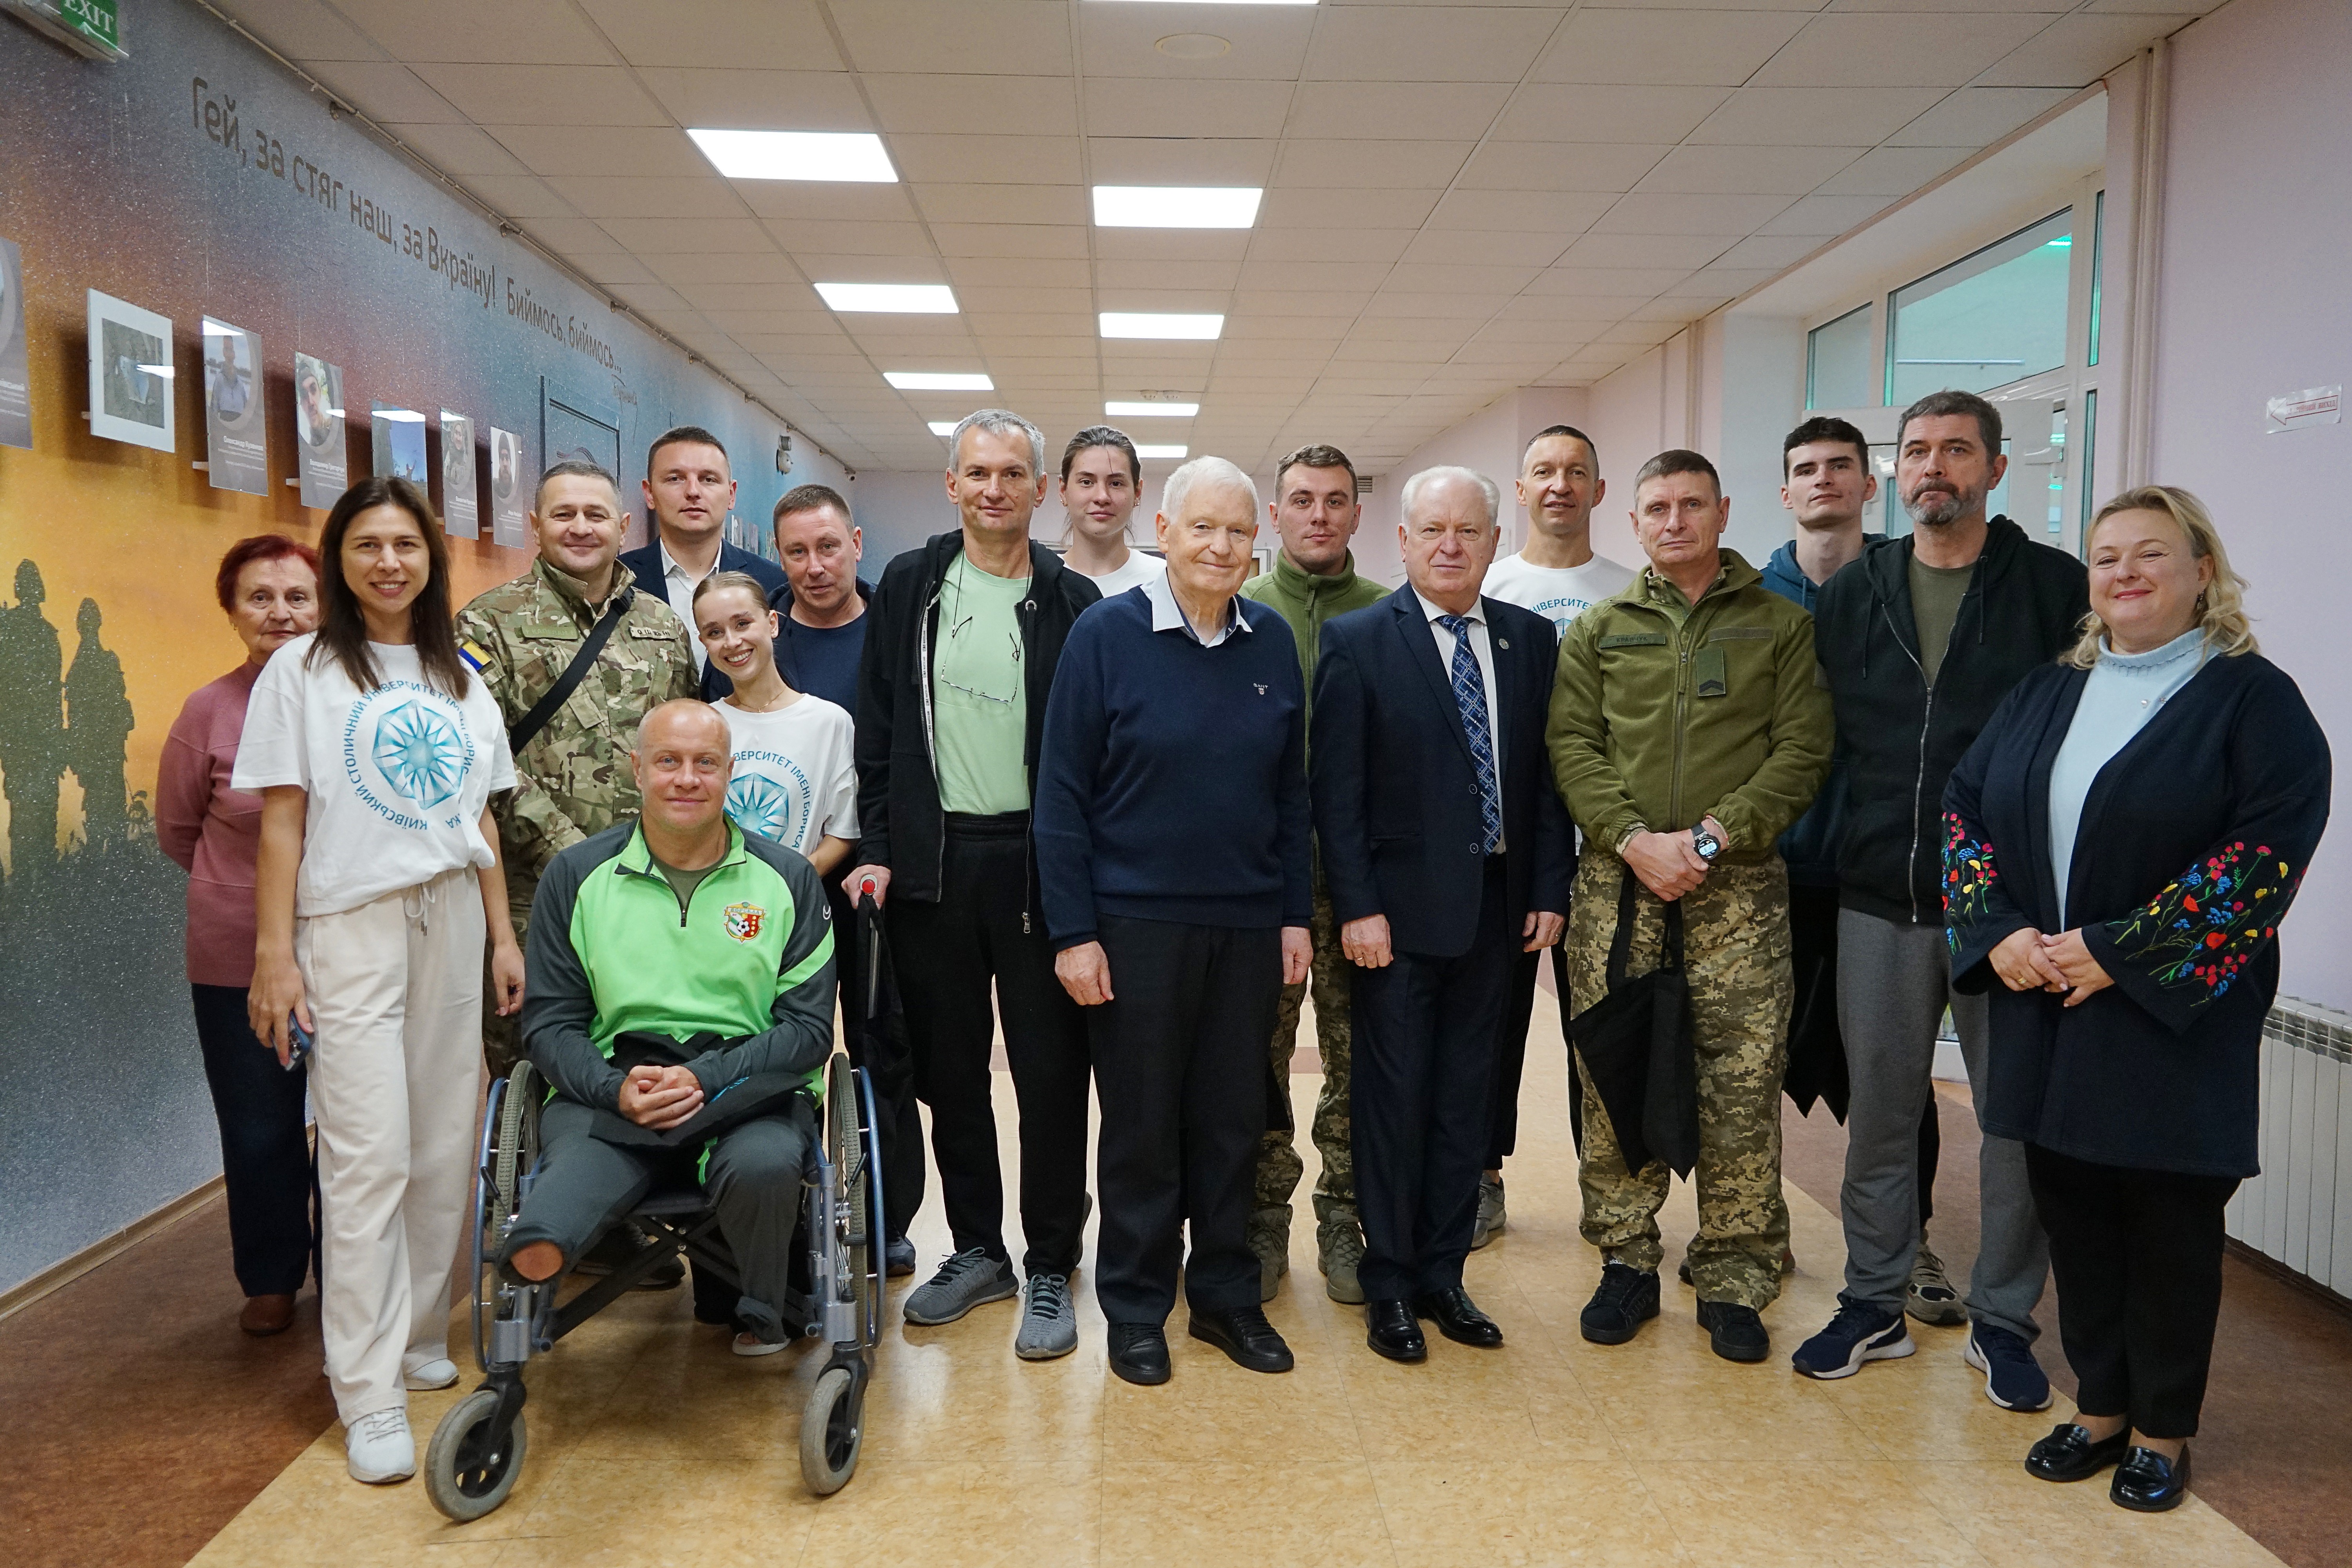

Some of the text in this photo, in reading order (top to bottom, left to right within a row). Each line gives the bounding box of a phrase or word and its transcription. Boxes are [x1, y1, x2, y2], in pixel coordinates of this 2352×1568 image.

[65, 0, 114, 34] EXIT
[193, 77, 246, 166] Гей,
[256, 129, 285, 180] за
[293, 155, 343, 212] стяг
[350, 190, 397, 254] наш,
[403, 223, 423, 261] за
[428, 227, 495, 309] Вкраїну!
[508, 277, 566, 348] Биймось,
[1530, 598, 1592, 613] НІВЕРСИТЕ
[343, 700, 367, 784] СТОЛИЧНИЙ
[464, 733, 475, 775] БОРИС
[790, 766, 810, 799] ІМЕНІ
[354, 784, 427, 830] КИЇВСЬКИЙ
[791, 801, 810, 848] БОРИСА
